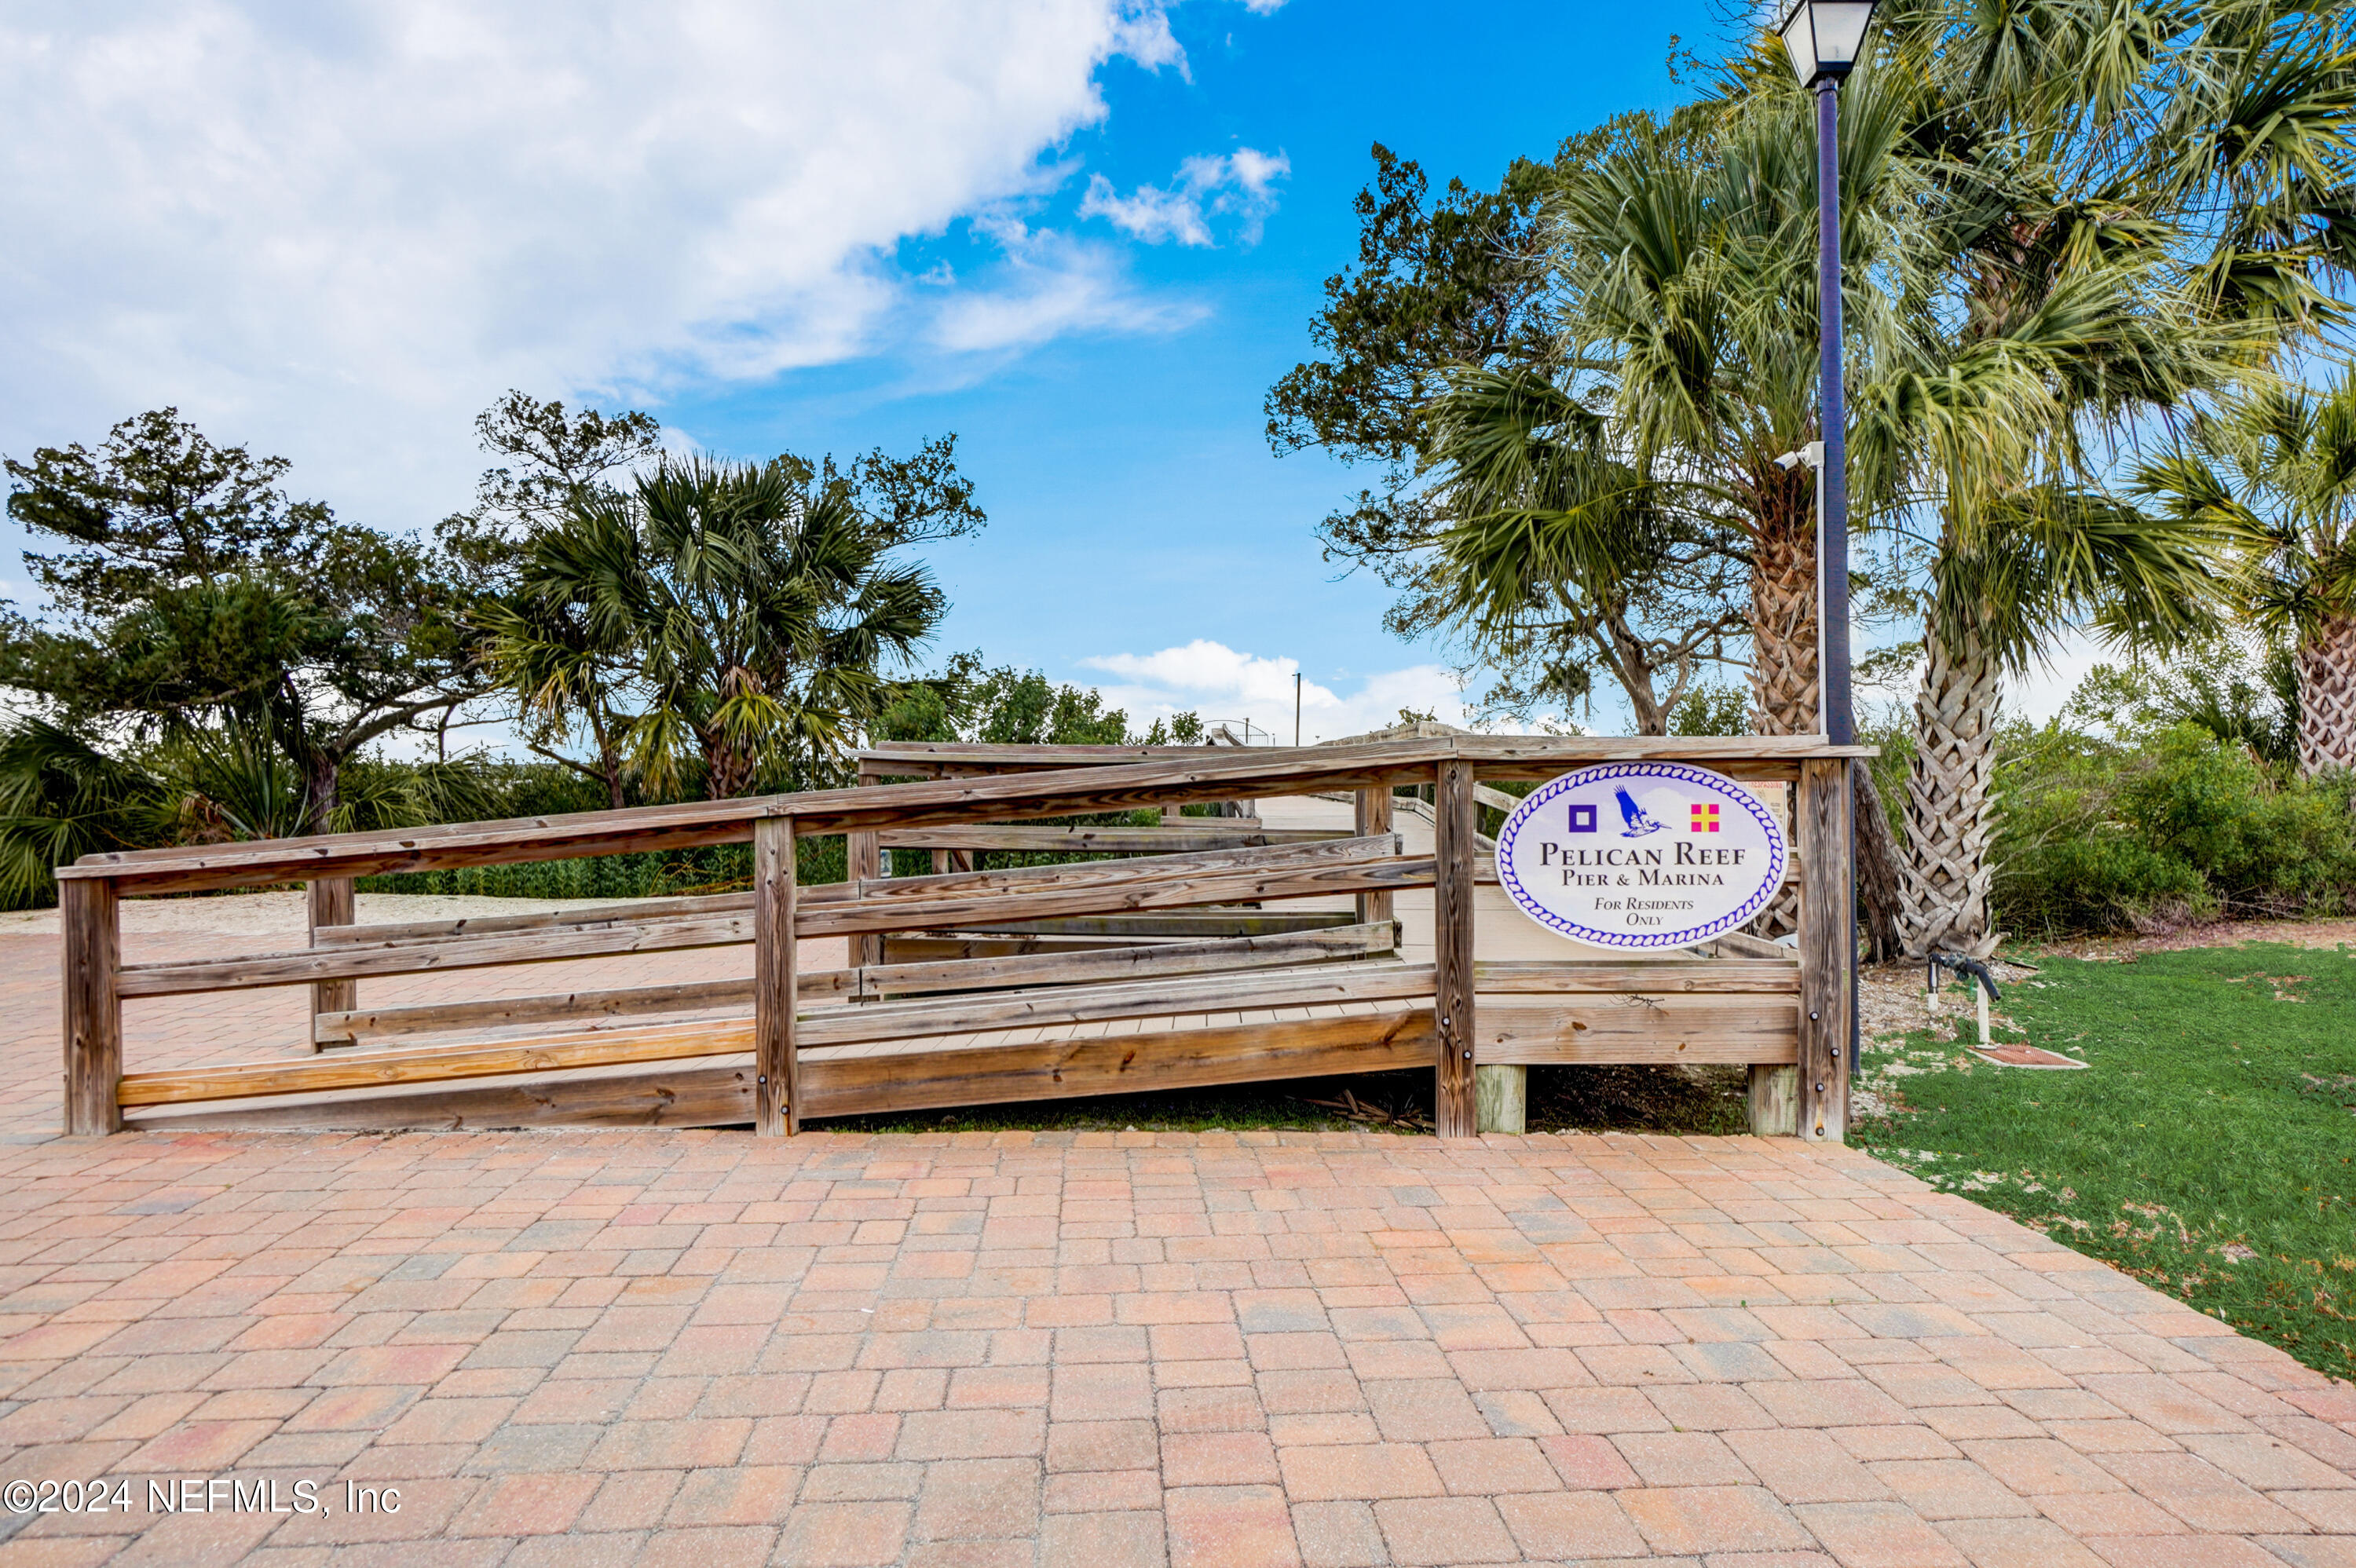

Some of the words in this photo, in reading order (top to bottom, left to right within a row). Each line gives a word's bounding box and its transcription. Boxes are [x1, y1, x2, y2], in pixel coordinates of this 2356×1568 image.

[1539, 842, 1663, 866] PELICAN
[1674, 841, 1746, 865] REEF
[1562, 868, 1609, 886] PIER
[1616, 874, 1630, 886] &
[1638, 868, 1725, 886] MARINA
[1594, 897, 1622, 910] FOR
[1626, 897, 1694, 910] RESIDENTS
[1626, 912, 1661, 926] ONLY
